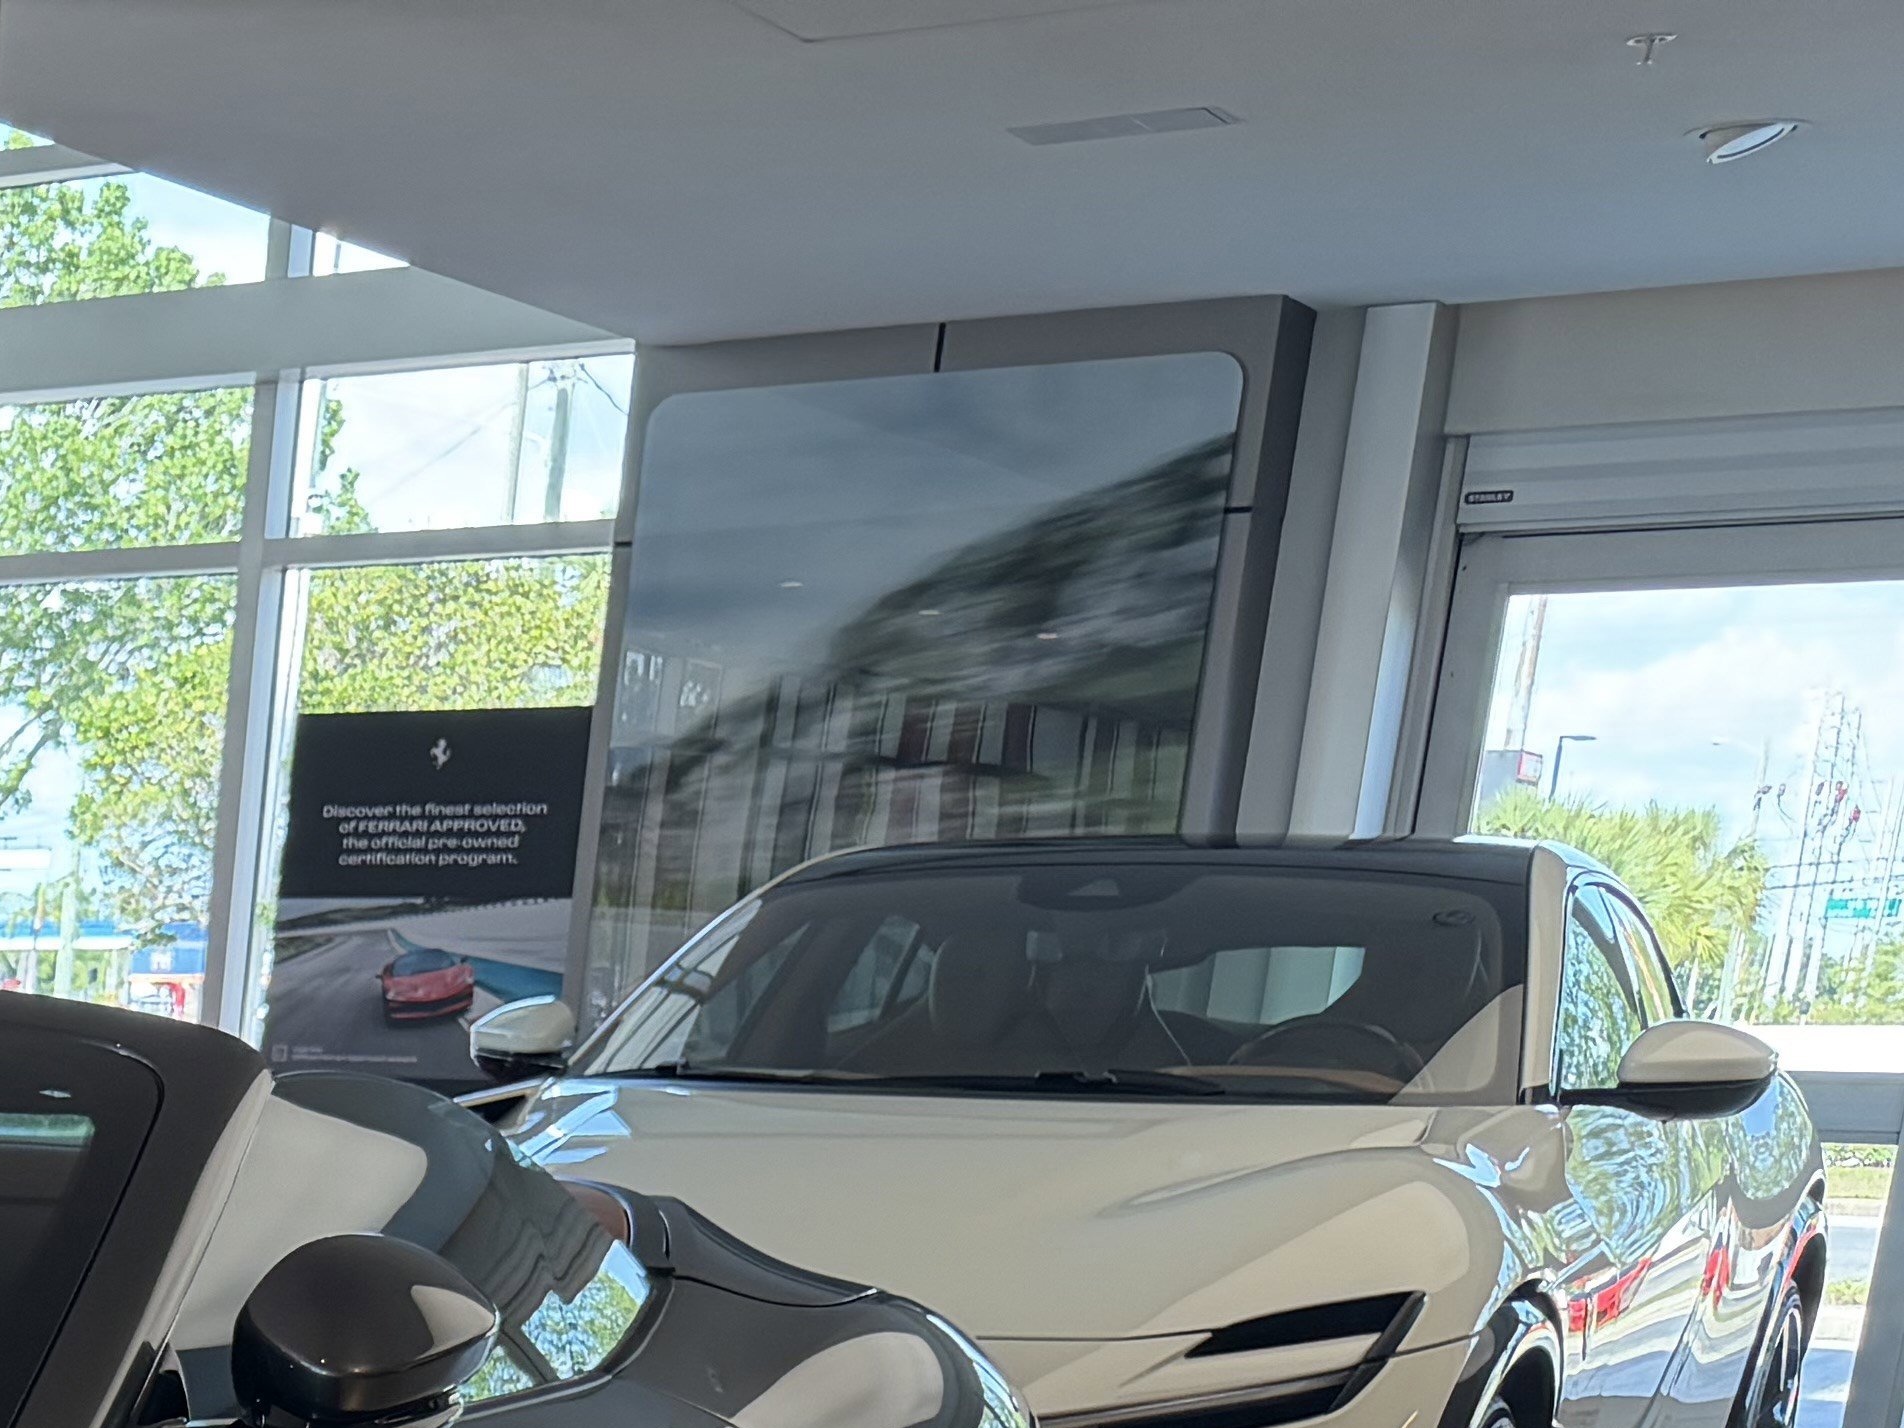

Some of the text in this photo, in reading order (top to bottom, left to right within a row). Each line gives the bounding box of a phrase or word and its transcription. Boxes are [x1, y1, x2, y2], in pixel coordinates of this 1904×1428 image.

[322, 802, 547, 818] Discover the finest selection
[339, 821, 357, 834] of
[358, 819, 427, 834] FERRARI
[343, 834, 519, 851] the official pre-owned
[339, 852, 518, 867] certification program.
